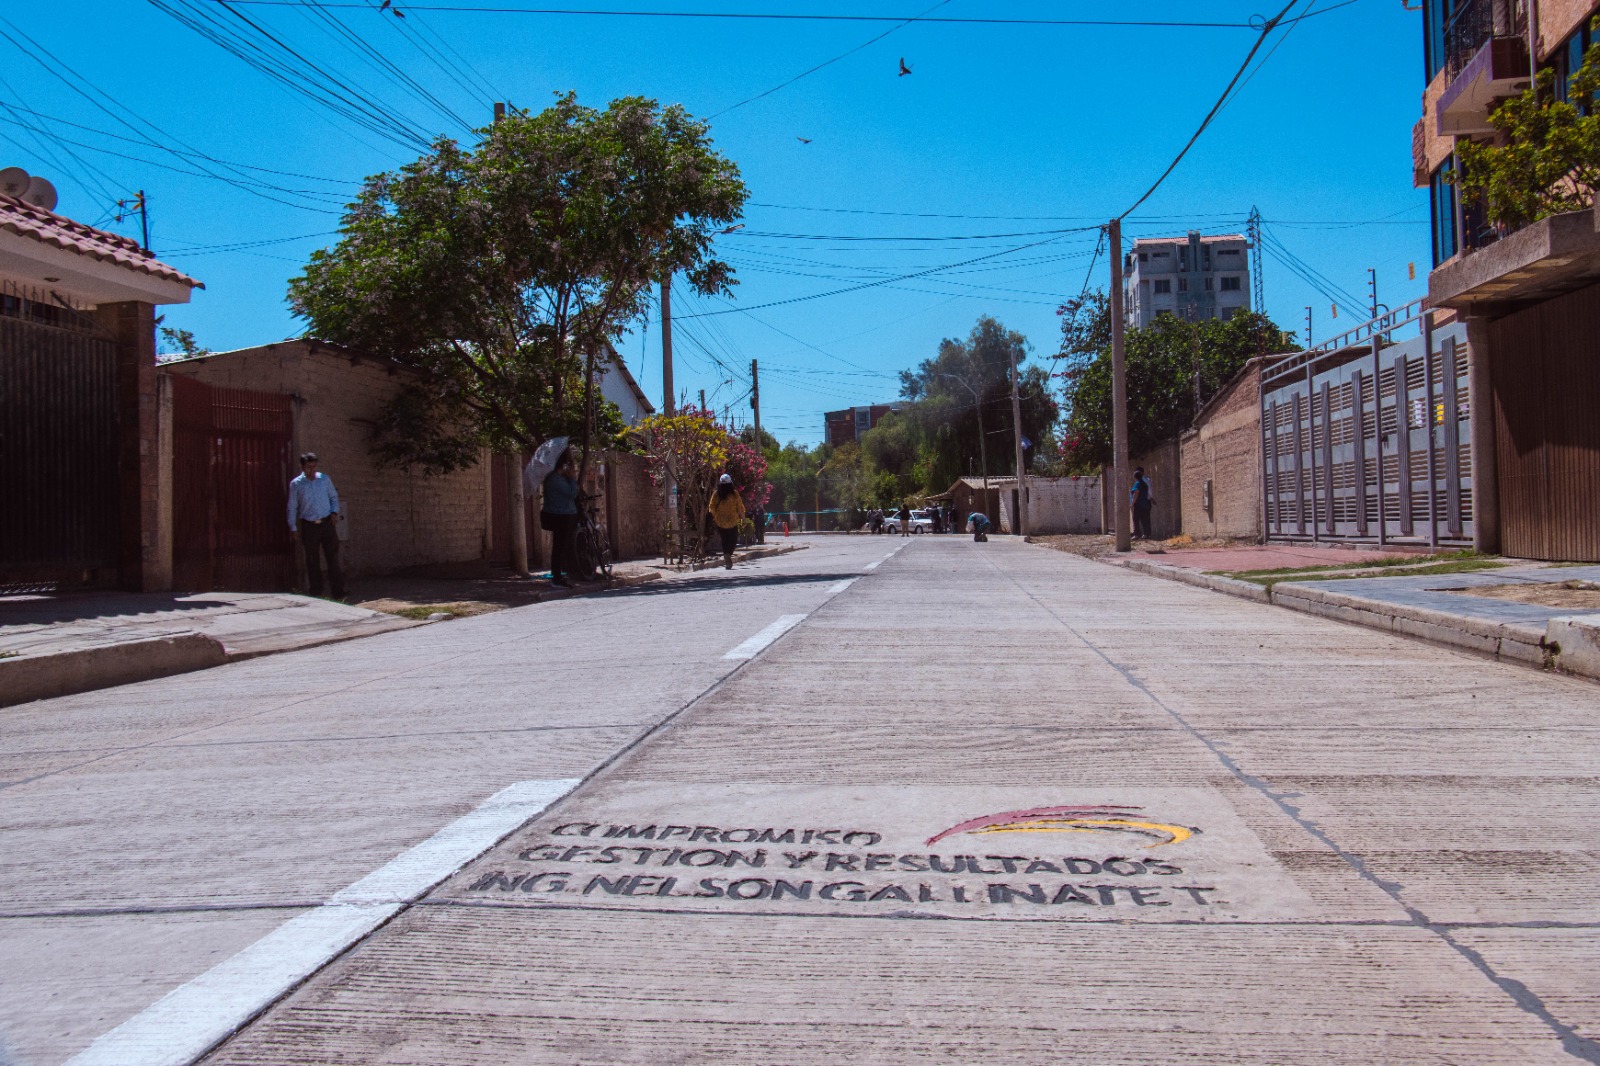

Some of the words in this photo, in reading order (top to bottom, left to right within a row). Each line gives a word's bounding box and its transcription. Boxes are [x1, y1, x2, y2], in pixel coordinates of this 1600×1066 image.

[518, 843, 768, 868] GESTION
[782, 850, 819, 869] Y
[825, 852, 1184, 876] RESULTADOS
[582, 873, 813, 900] NELSON
[819, 880, 1172, 906] GALLINATE
